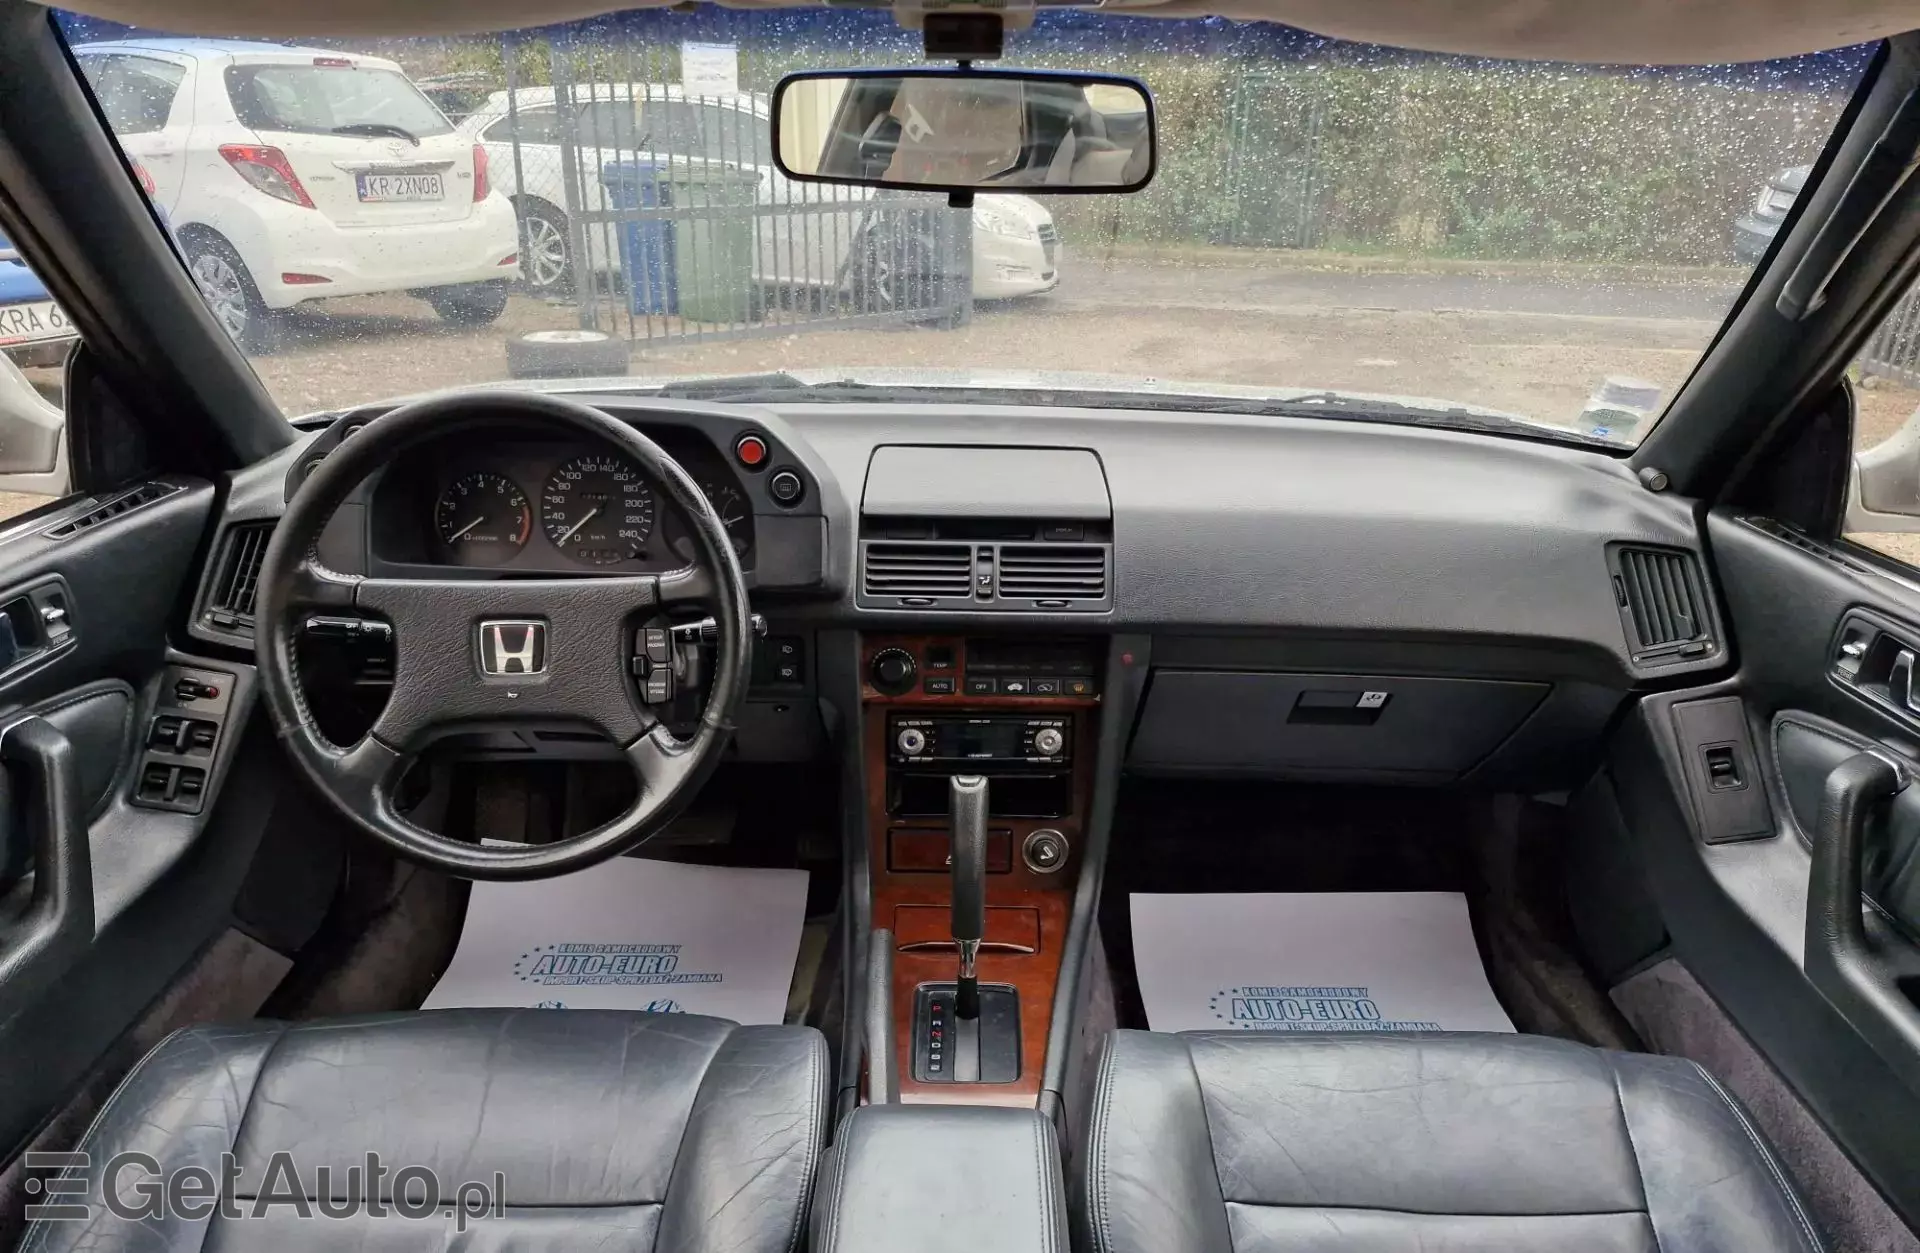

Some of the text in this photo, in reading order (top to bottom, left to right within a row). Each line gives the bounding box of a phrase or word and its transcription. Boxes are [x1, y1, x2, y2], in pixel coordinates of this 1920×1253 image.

[368, 177, 439, 196] KR 2XN08
[0, 307, 44, 335] KRA
[582, 464, 597, 472] 120
[600, 464, 615, 472] 140
[566, 472, 582, 480] 100
[497, 486, 504, 494] 5
[558, 482, 571, 490] 80
[510, 498, 517, 507] 6
[552, 496, 565, 504] 60
[625, 500, 644, 508] 200
[449, 502, 456, 510] 2
[552, 512, 565, 520] 40
[625, 515, 644, 523] 220
[557, 526, 570, 534] 20
[619, 530, 638, 538] 240
[574, 534, 581, 542] 0
[932, 682, 948, 690] AUTO
[558, 943, 682, 953] KOMIS SAMOCHODOWY
[530, 954, 678, 976] AUTO-EURO
[1242, 987, 1368, 997] KOMIS SAMOCHODOWY
[1232, 998, 1381, 1021] AUTO-EURO
